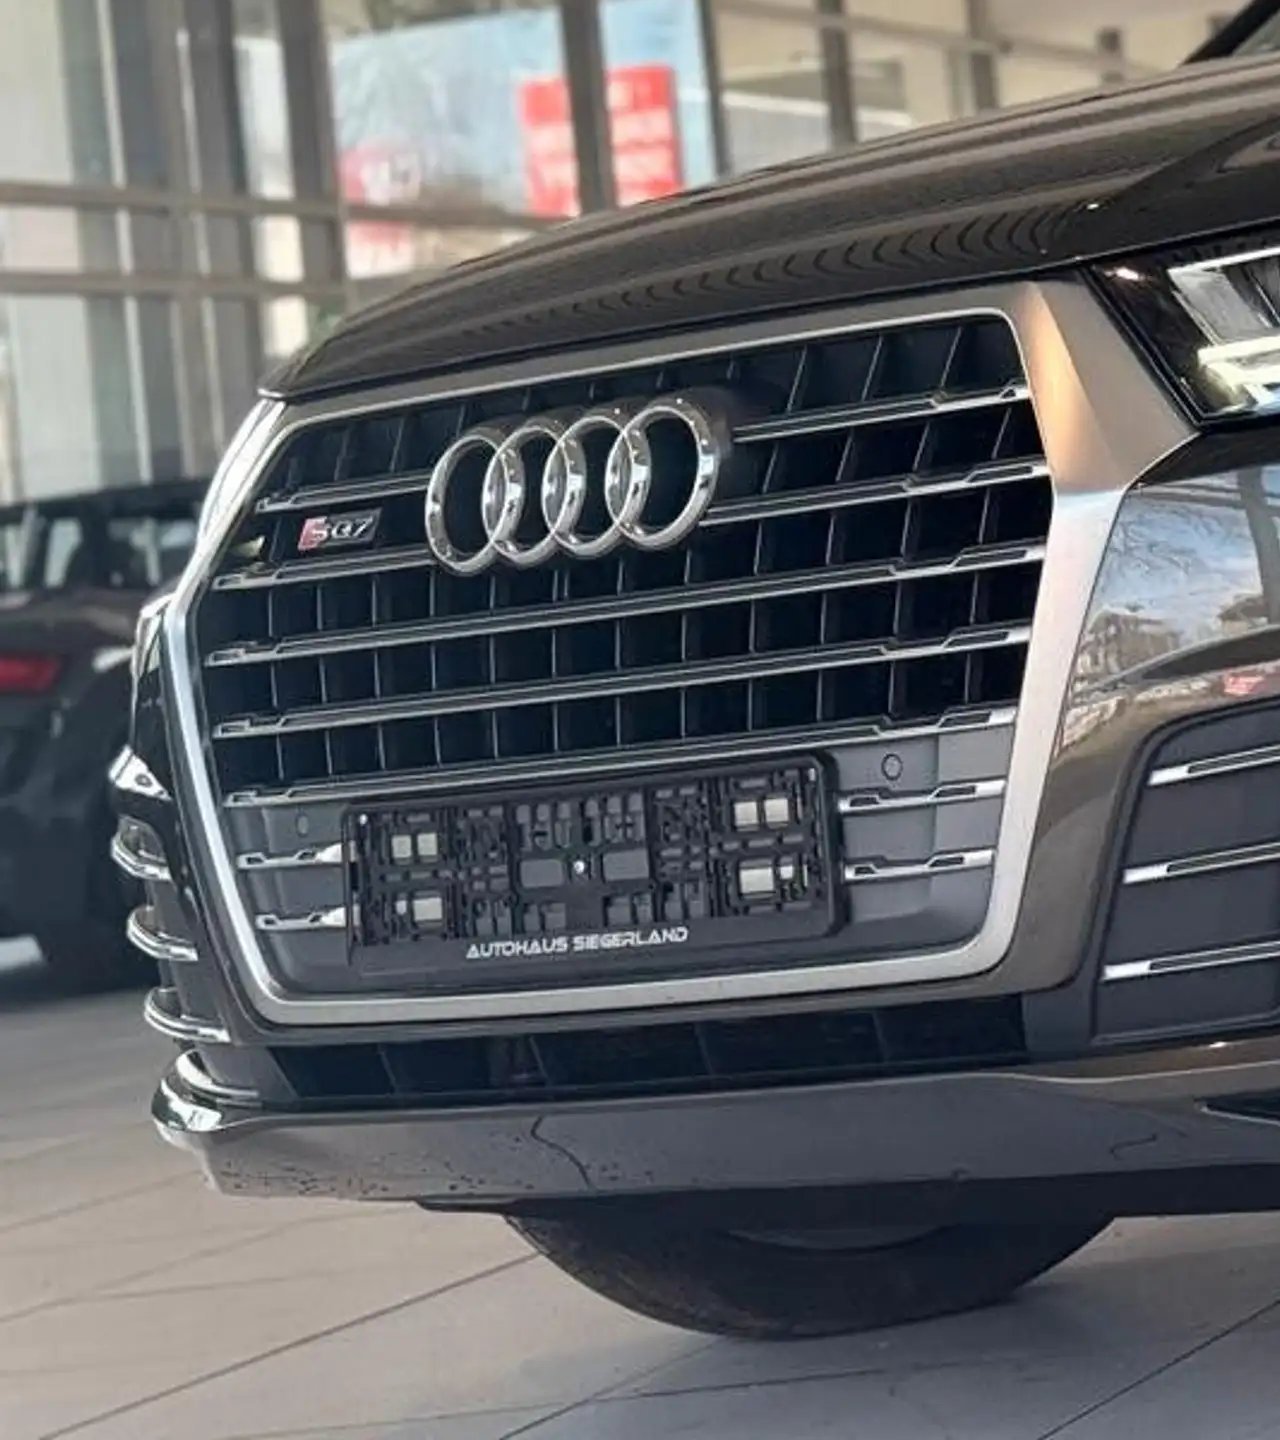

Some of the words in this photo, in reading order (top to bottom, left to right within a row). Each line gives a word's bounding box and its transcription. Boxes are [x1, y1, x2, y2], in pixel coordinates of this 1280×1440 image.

[299, 515, 374, 551] SQ7
[466, 936, 568, 959] AUTOHAUS
[573, 926, 689, 952] SIEGERLAND
